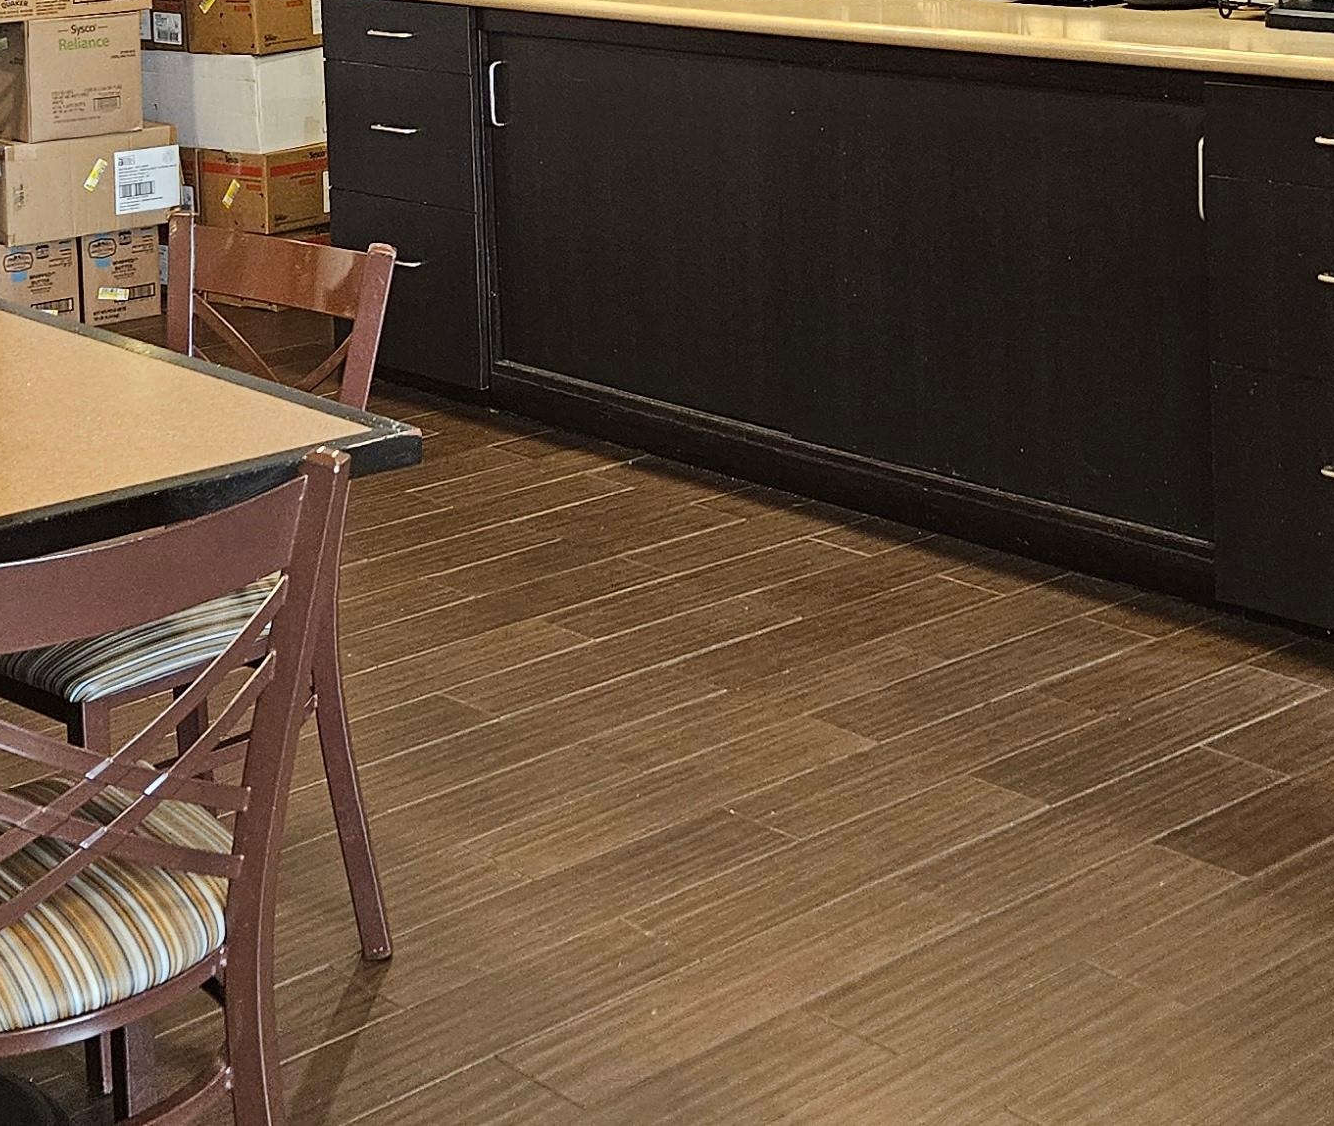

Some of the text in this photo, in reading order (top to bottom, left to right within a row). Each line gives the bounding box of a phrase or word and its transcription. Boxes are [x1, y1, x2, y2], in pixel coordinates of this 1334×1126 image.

[0, 0, 28, 9] QUAKER
[70, 25, 96, 35] Sysco
[58, 36, 110, 51] Reliance
